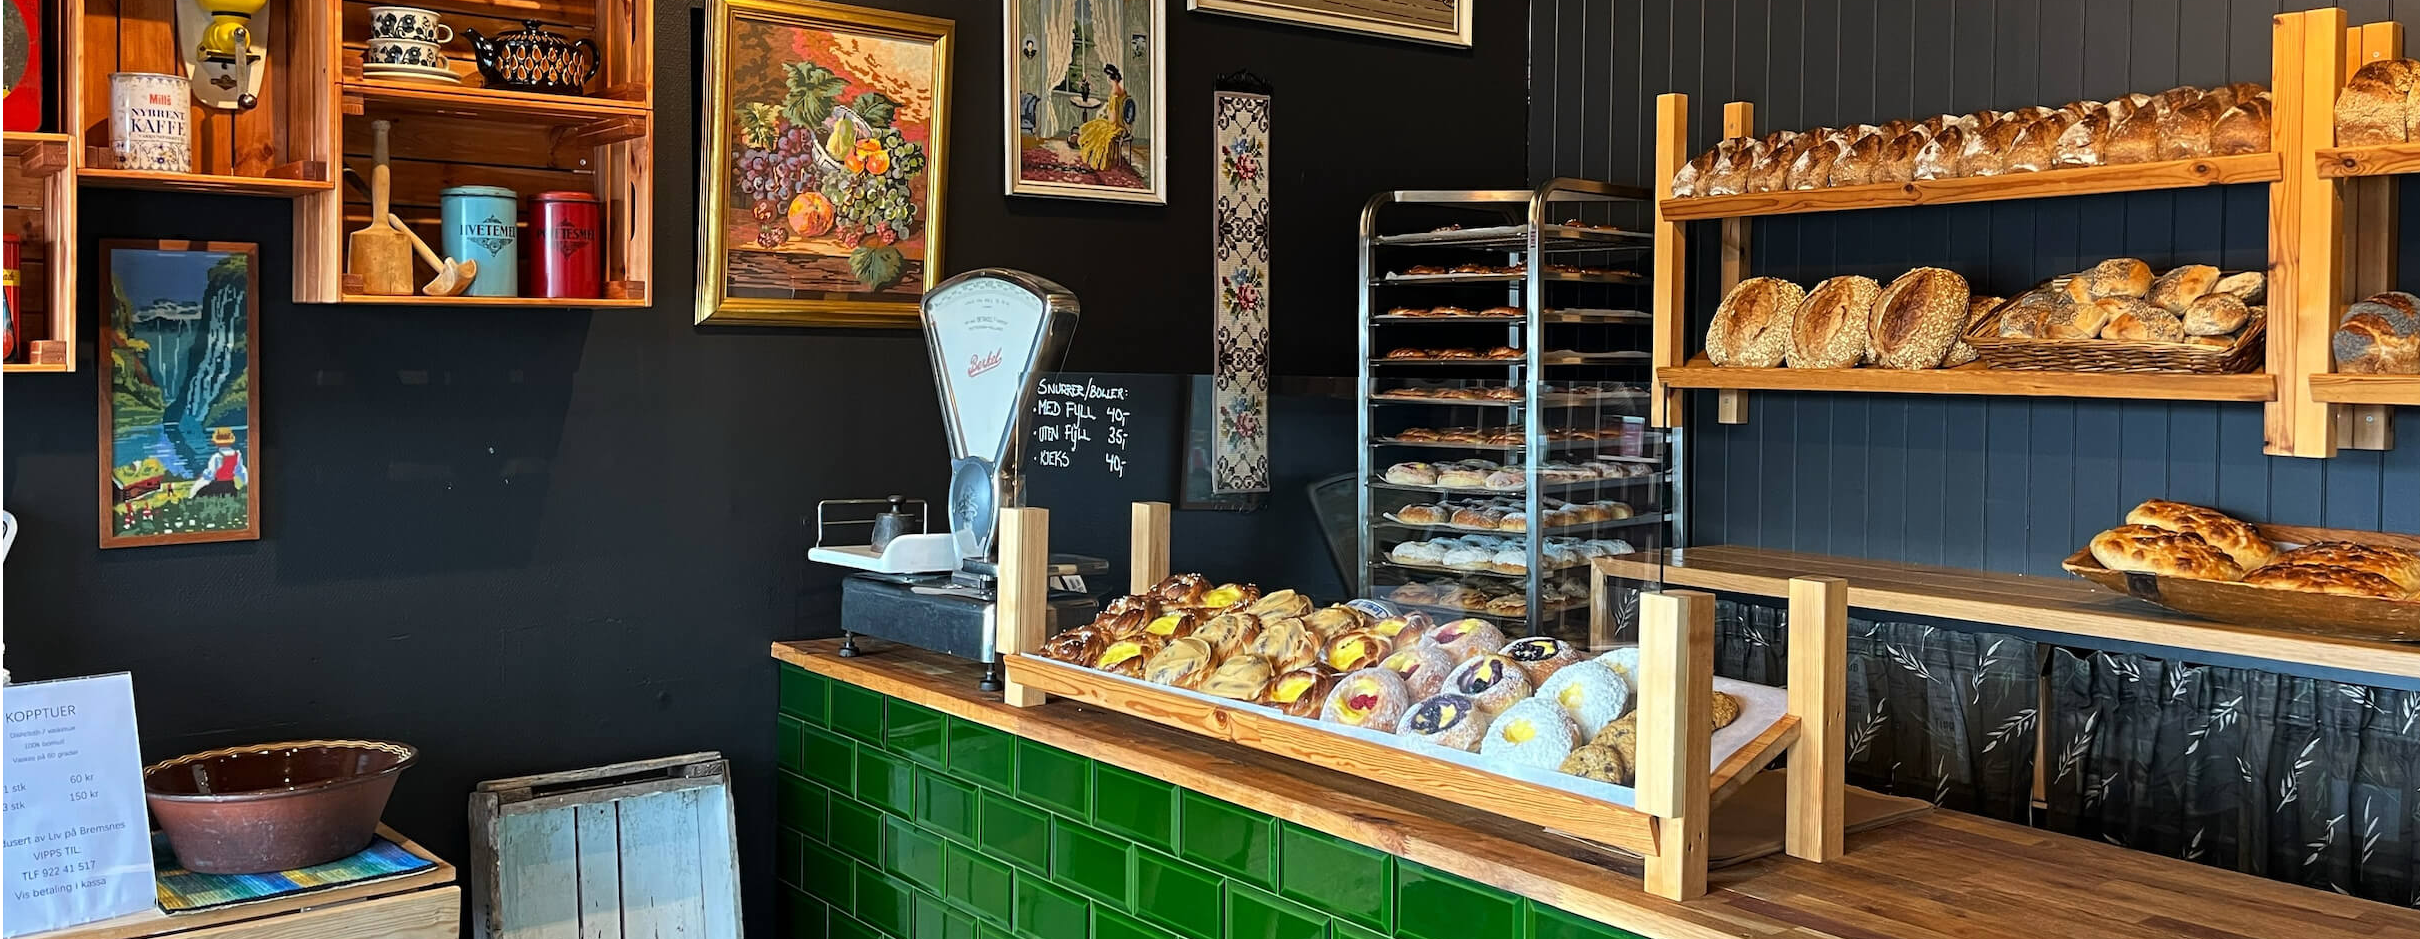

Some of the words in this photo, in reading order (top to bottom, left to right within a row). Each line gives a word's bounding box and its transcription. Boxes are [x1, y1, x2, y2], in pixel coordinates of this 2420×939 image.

[131, 118, 186, 136] KAFFE
[1038, 399, 1061, 416] MED
[1106, 406, 1131, 427] 40,-
[1107, 426, 1128, 450] 35,-
[1040, 450, 1070, 467] KJEKS
[1105, 453, 1127, 478] 40,-
[5, 704, 76, 724] KOPPTUER
[12, 783, 27, 793] stk
[70, 774, 82, 784] 60
[85, 773, 94, 782] kr
[11, 800, 26, 811] stk
[70, 790, 88, 801] 150
[90, 789, 99, 799] kr
[34, 835, 46, 843] av
[65, 827, 77, 840] på
[80, 821, 126, 836] Bremsnes
[33, 848, 62, 861] VIPPS
[22, 869, 40, 881] TLF
[42, 866, 60, 878] 922
[63, 864, 75, 874] 41
[78, 859, 96, 871] 517
[14, 889, 30, 901] Vis
[33, 882, 73, 898] betaling
[81, 877, 107, 889] kassa
